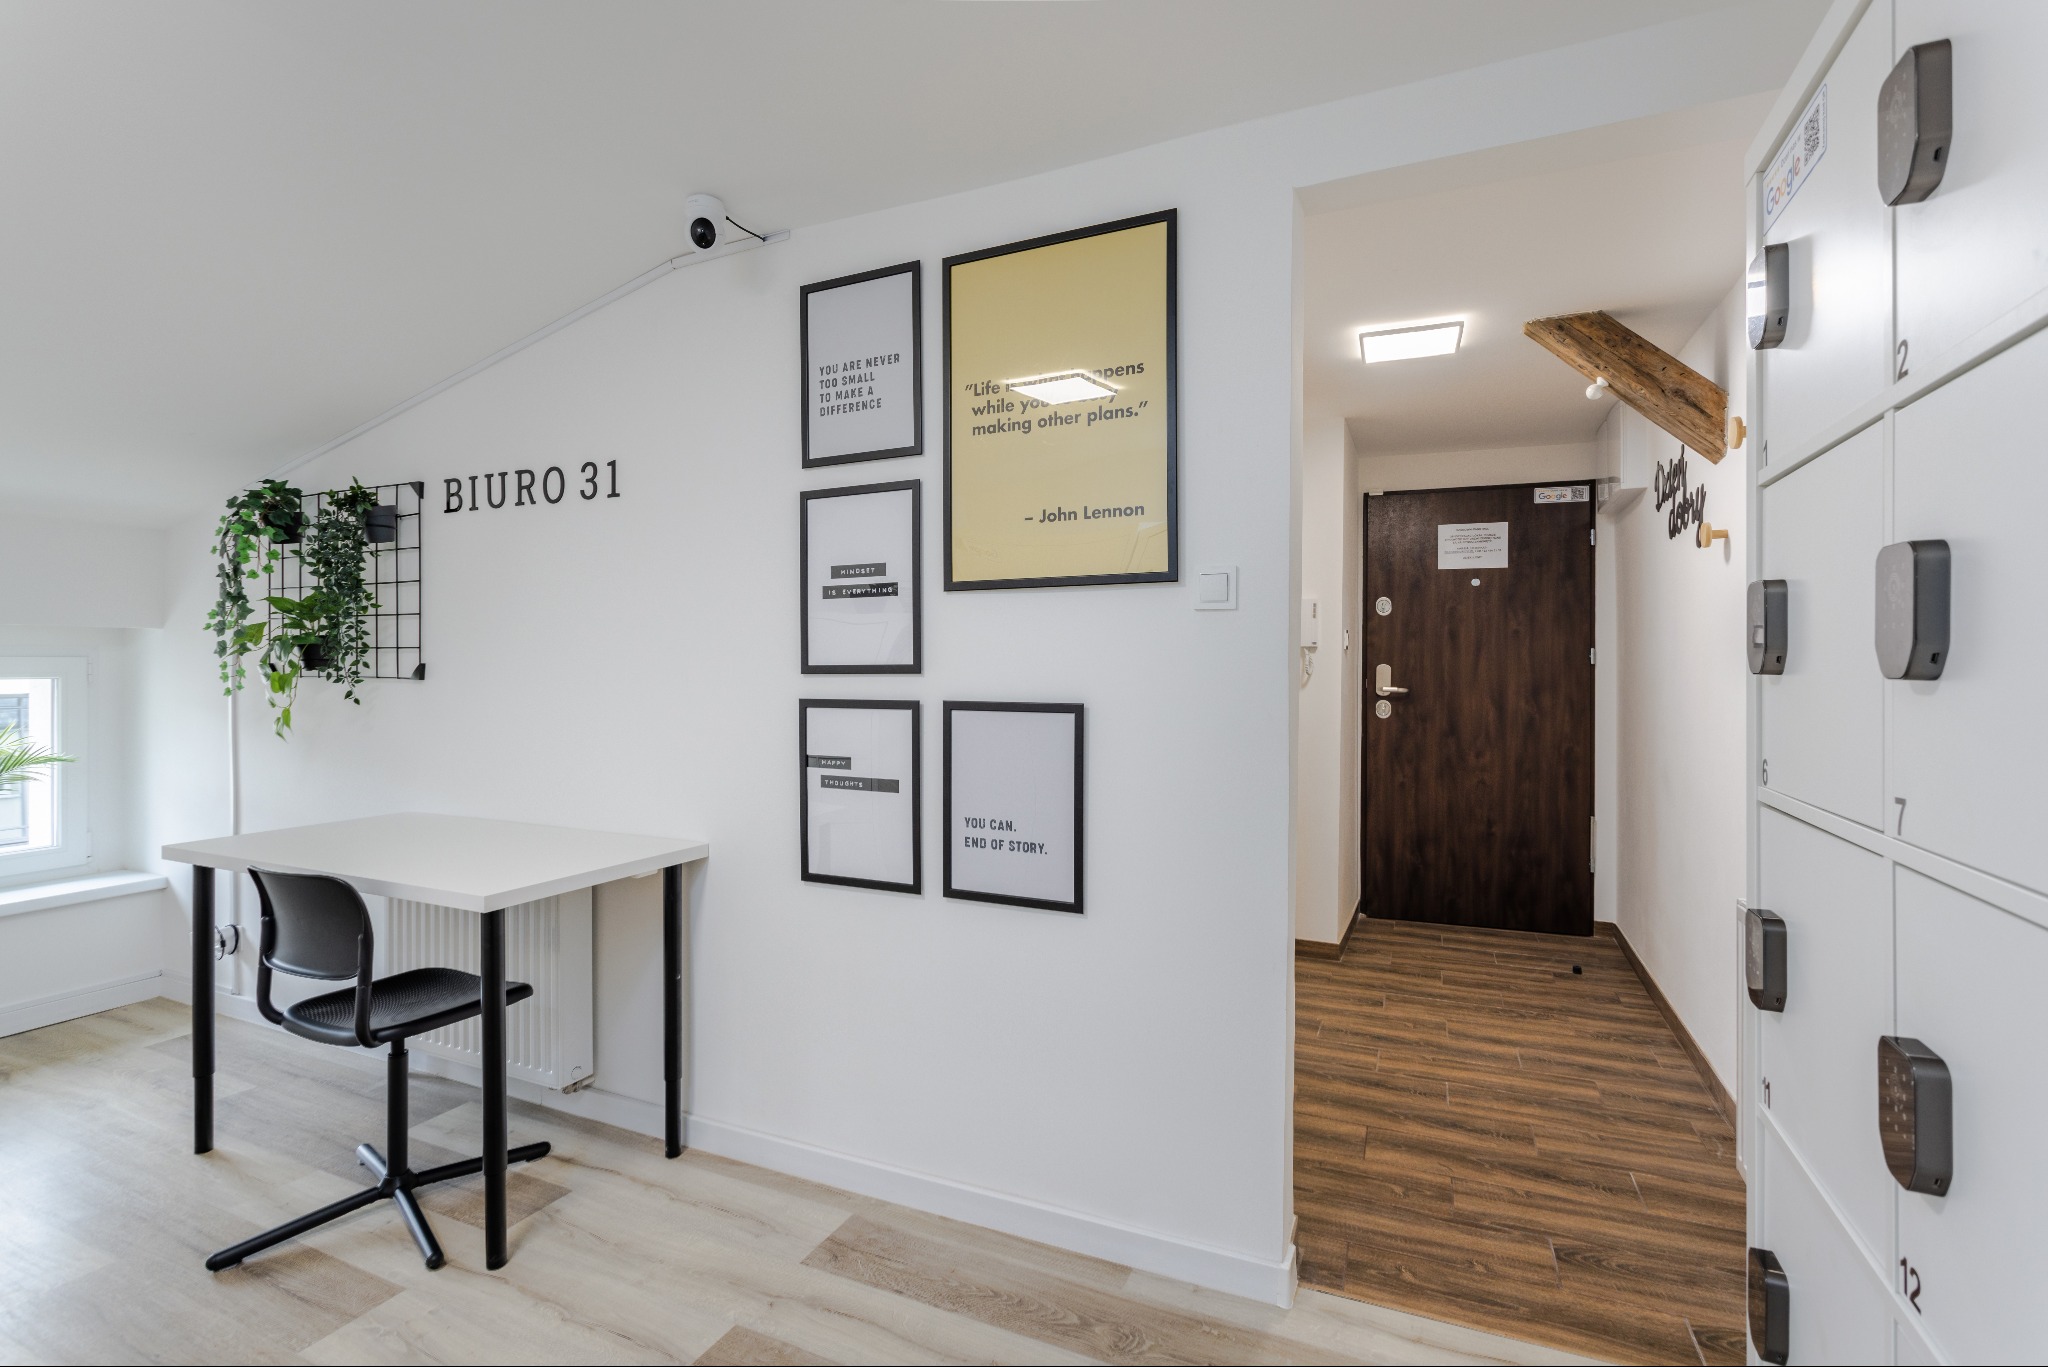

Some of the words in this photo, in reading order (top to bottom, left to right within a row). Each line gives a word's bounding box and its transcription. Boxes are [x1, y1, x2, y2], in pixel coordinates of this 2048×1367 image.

[1766, 153, 1801, 216] Google
[819, 363, 839, 377] YOU
[842, 359, 862, 373] ARE
[865, 353, 900, 369] NEVER
[1897, 339, 1909, 382] 2
[819, 377, 838, 390] TOO
[841, 371, 875, 386] SMALL
[819, 392, 831, 404] TO
[835, 386, 863, 401] MAKE
[867, 385, 874, 396] A
[819, 397, 882, 417] DIFFERENCE
[971, 397, 1015, 416] while
[972, 417, 1032, 436] making
[1037, 411, 1082, 428] other
[1763, 440, 1768, 467] 1
[443, 465, 566, 514] BIURO
[579, 459, 621, 501] 31
[1538, 491, 1568, 501] Google
[1039, 506, 1078, 523] John
[1083, 505, 1145, 520] Lennon
[840, 567, 876, 575] MINDSET
[842, 586, 893, 595] EVERYTHING
[1762, 758, 1769, 787] 6
[824, 779, 863, 788] THOUGHTS
[964, 816, 986, 829] YOU
[989, 819, 1017, 832] CAN.
[1894, 796, 1907, 837] 7
[964, 836, 987, 849] END
[990, 838, 1005, 851] OF
[1008, 840, 1048, 855] STORY.
[1900, 1256, 1922, 1316] 12
